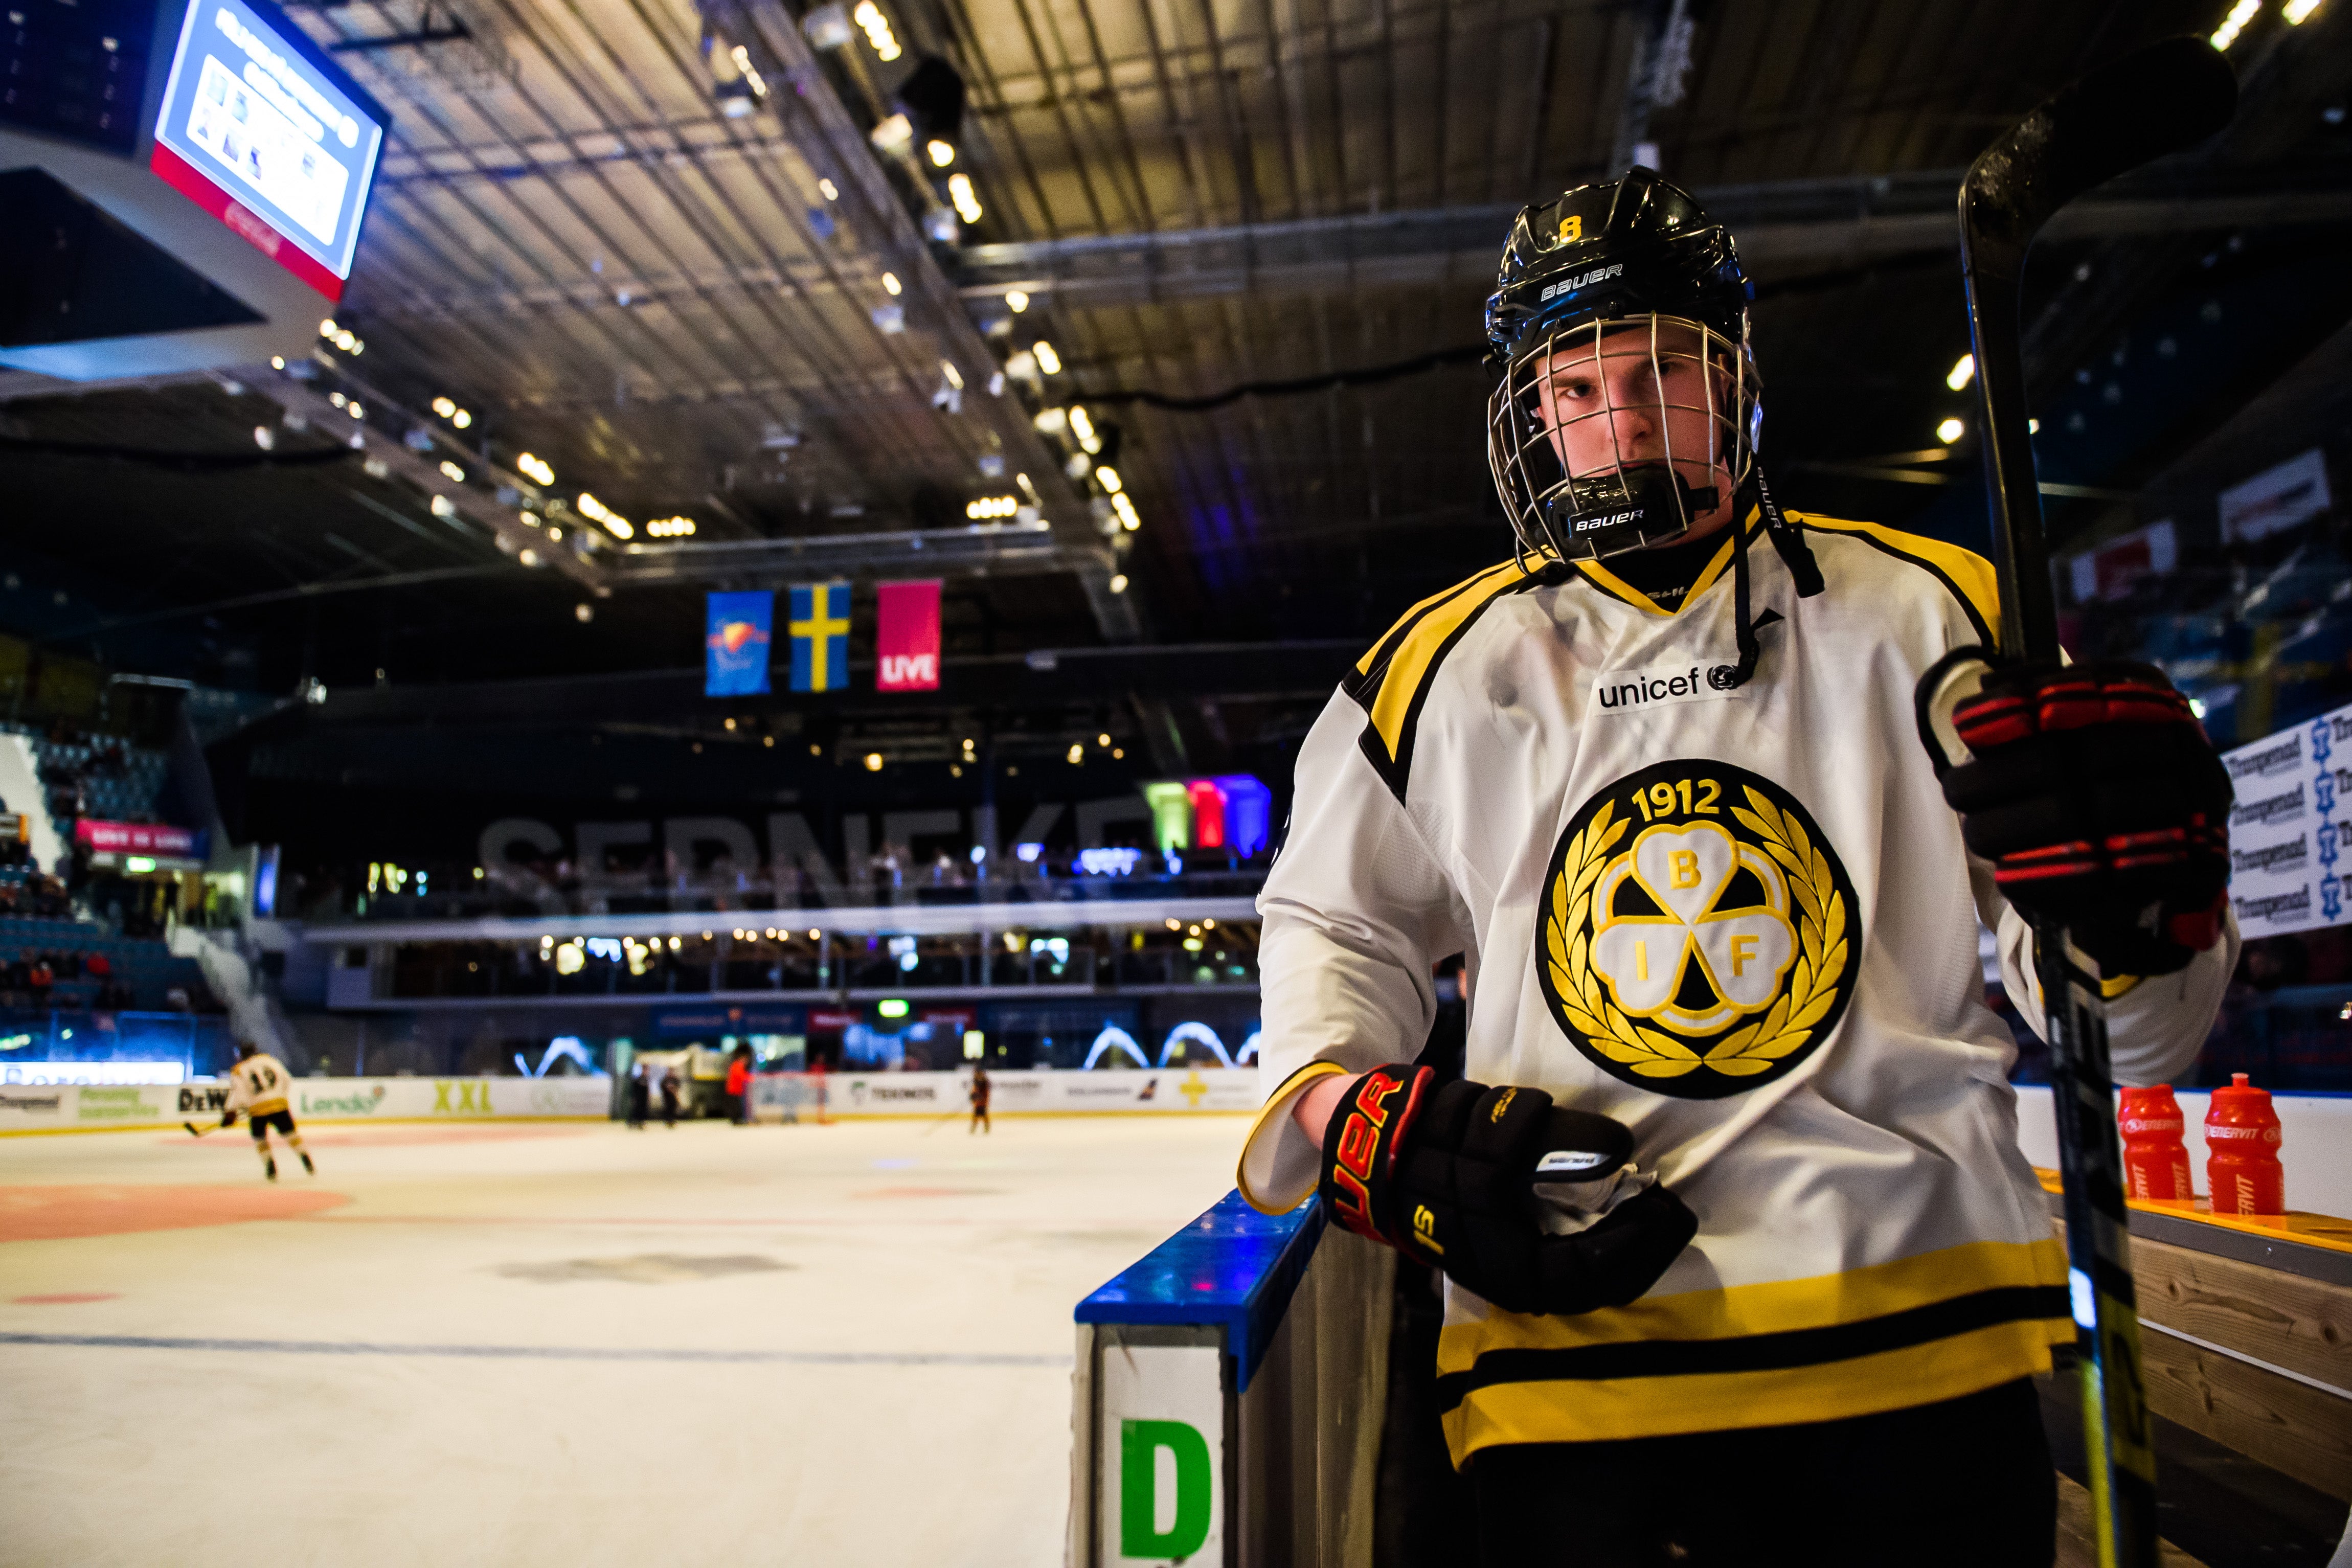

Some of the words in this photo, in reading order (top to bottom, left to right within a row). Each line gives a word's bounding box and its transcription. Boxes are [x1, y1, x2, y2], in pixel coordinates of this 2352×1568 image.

[1559, 215, 1581, 243] 8
[1541, 264, 1623, 302] BAUER
[1576, 509, 1645, 532] BAUER
[1599, 667, 1699, 708] unicef
[1632, 779, 1722, 822] 1912
[1667, 850, 1701, 890] B
[1121, 1419, 1212, 1559] D
